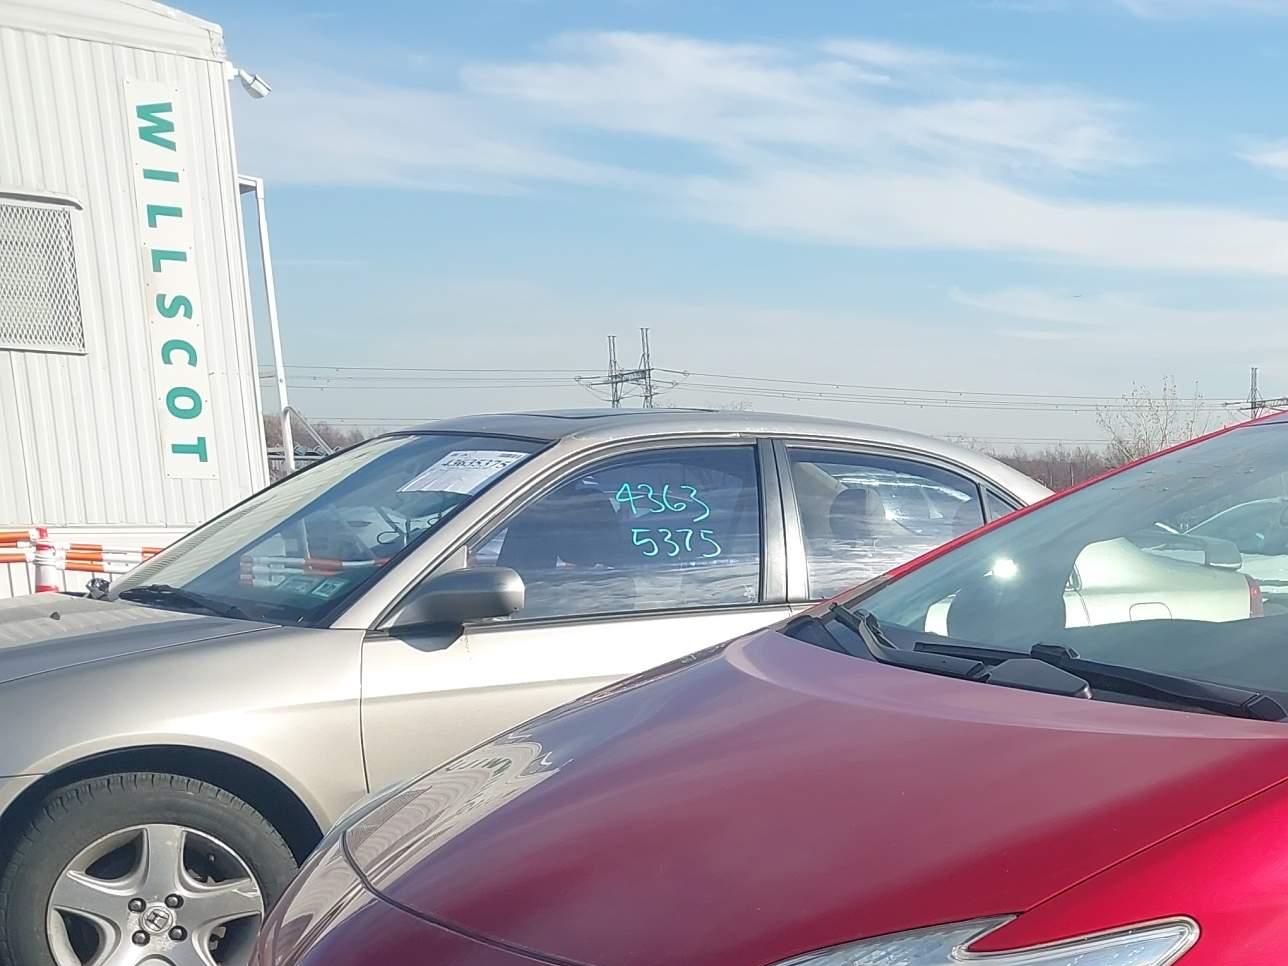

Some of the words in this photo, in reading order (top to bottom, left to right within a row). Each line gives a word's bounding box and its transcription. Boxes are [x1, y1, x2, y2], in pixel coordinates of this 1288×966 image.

[135, 101, 208, 463] WILLSCOT
[616, 483, 710, 522] 4363
[631, 528, 721, 558] 5375
